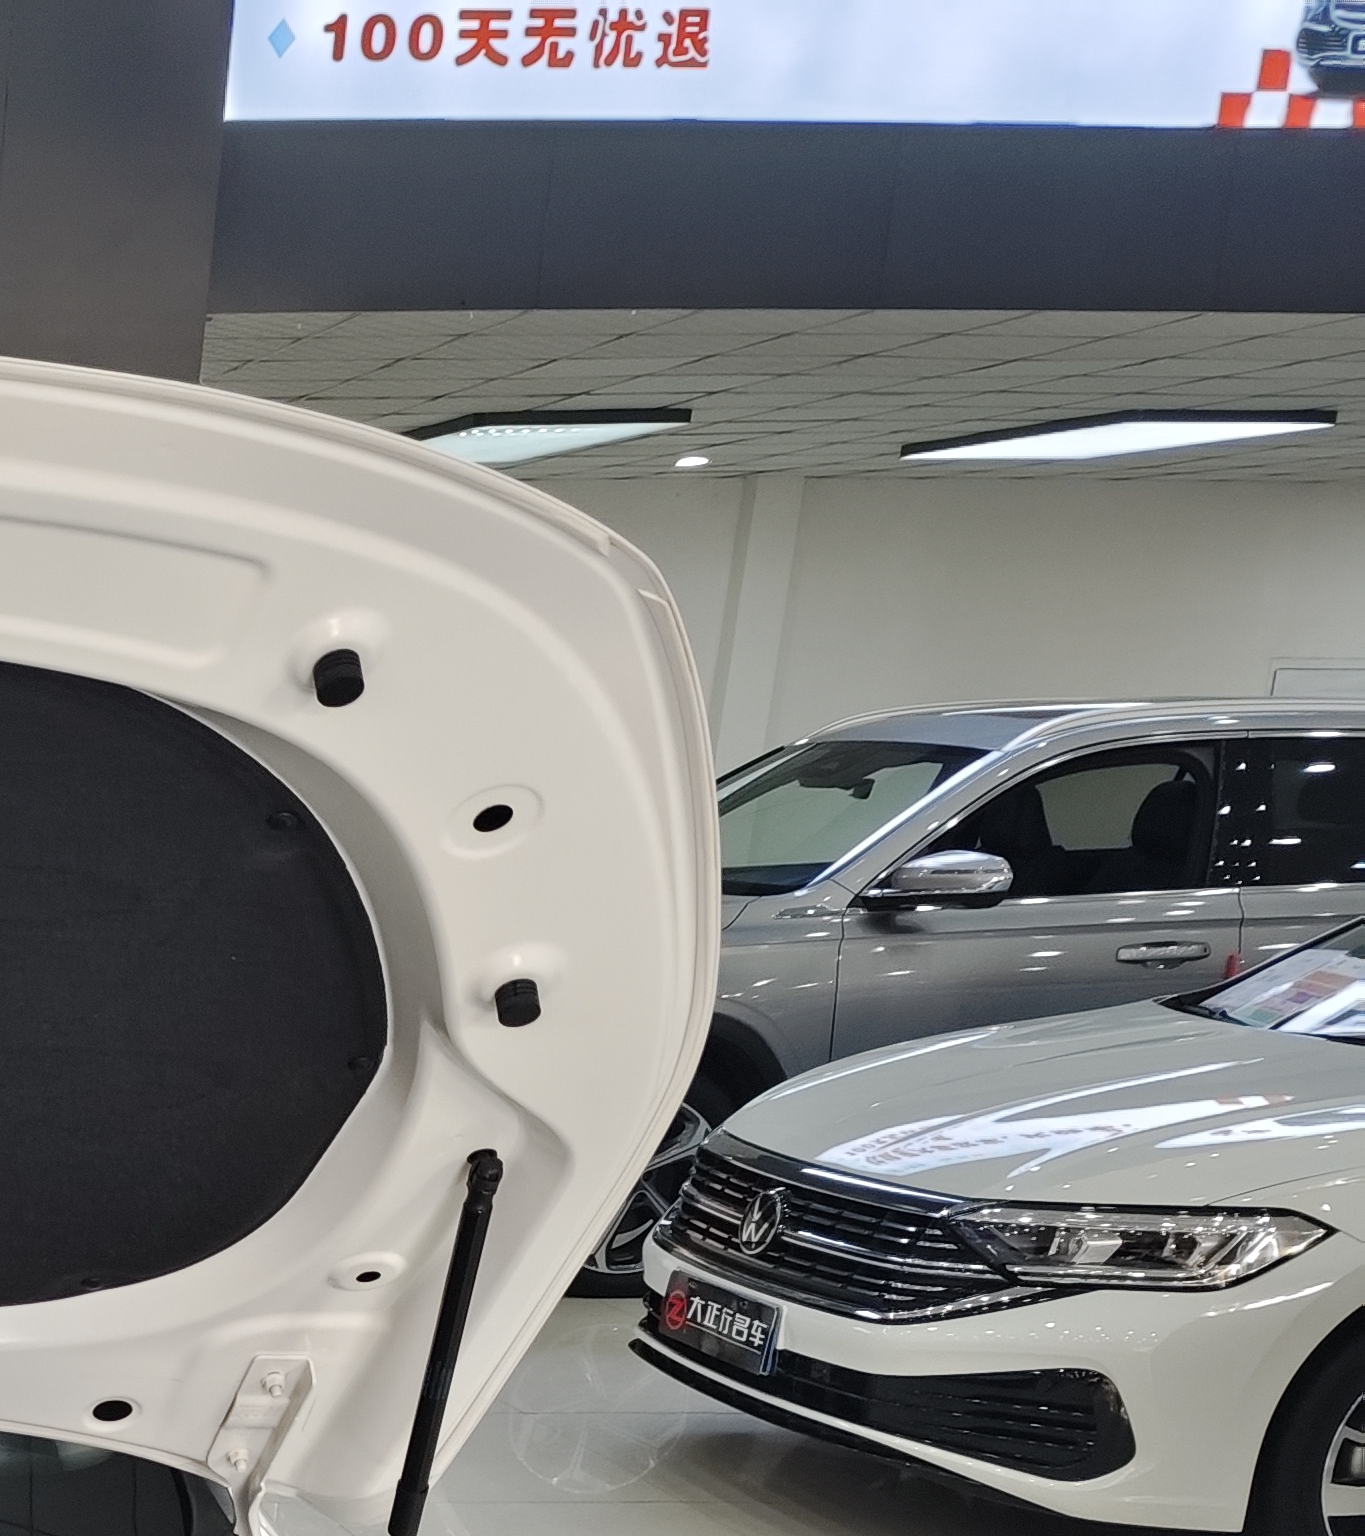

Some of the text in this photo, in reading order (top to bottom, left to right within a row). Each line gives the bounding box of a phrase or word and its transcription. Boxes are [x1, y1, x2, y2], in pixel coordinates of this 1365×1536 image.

[323, 8, 710, 69] 100天无忧退
[686, 1296, 768, 1348] 大正行名车
